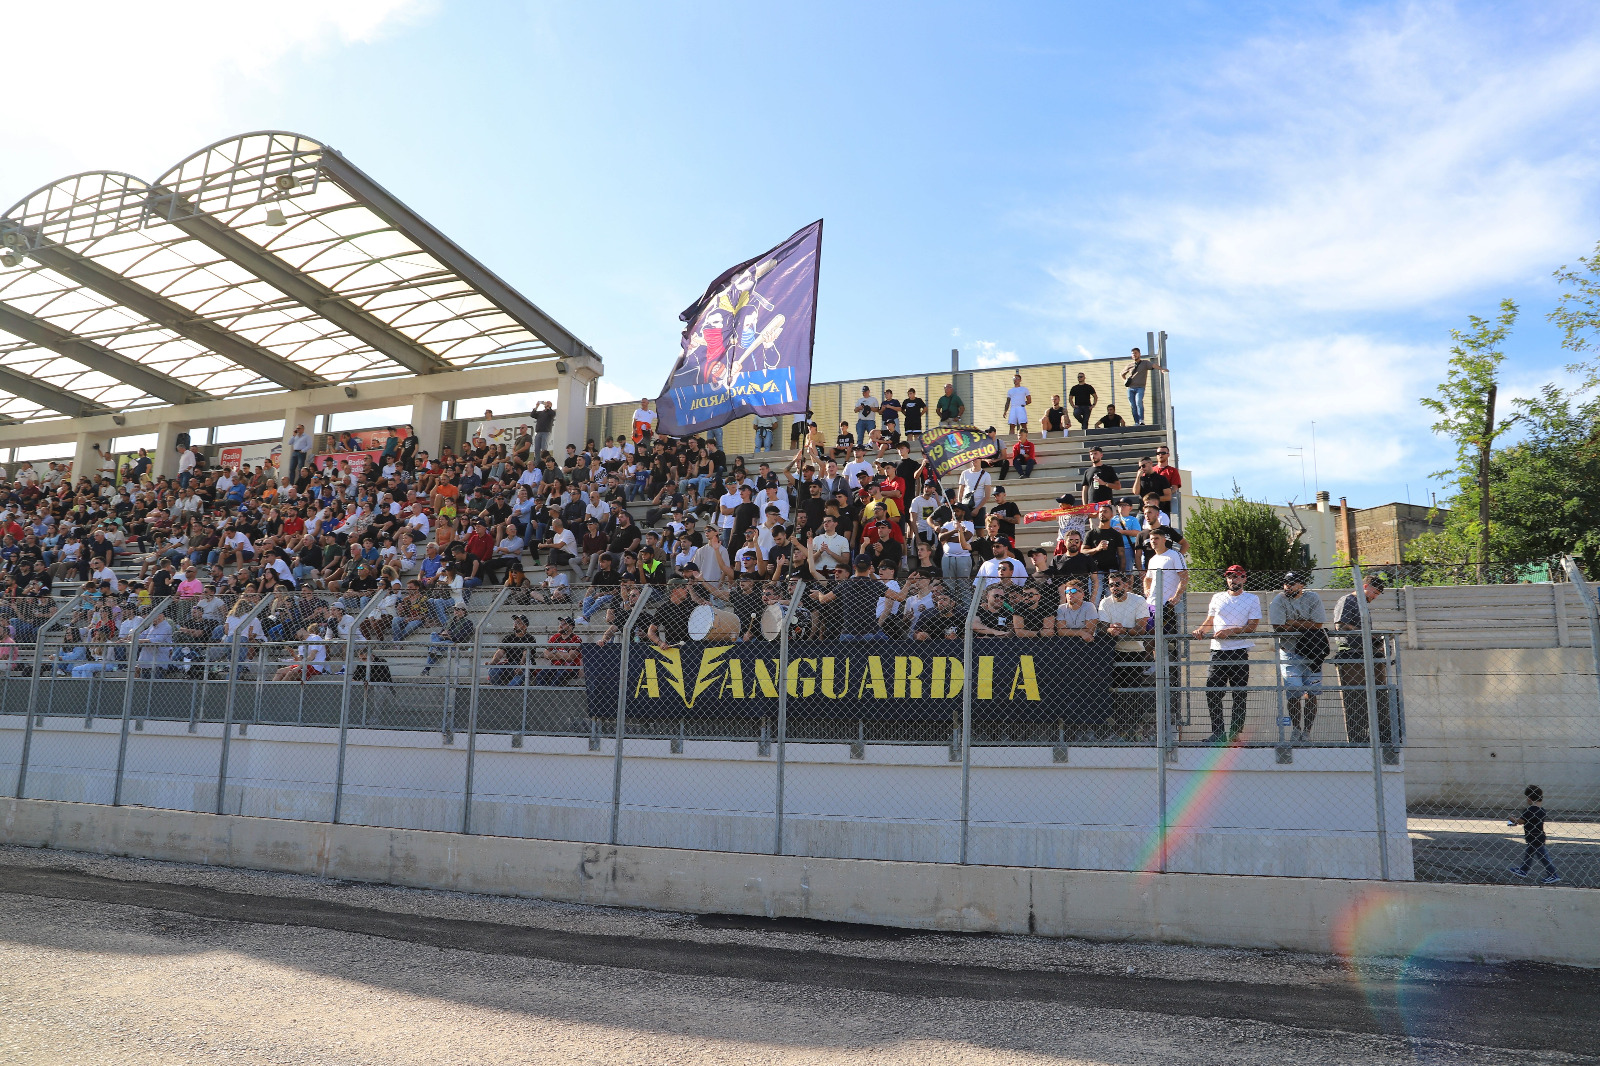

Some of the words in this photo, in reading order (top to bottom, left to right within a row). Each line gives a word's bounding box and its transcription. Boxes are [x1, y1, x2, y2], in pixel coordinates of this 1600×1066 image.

[223, 452, 240, 460] Radio
[929, 444, 944, 461] 19
[634, 645, 1041, 708] AVANGUARDIA
